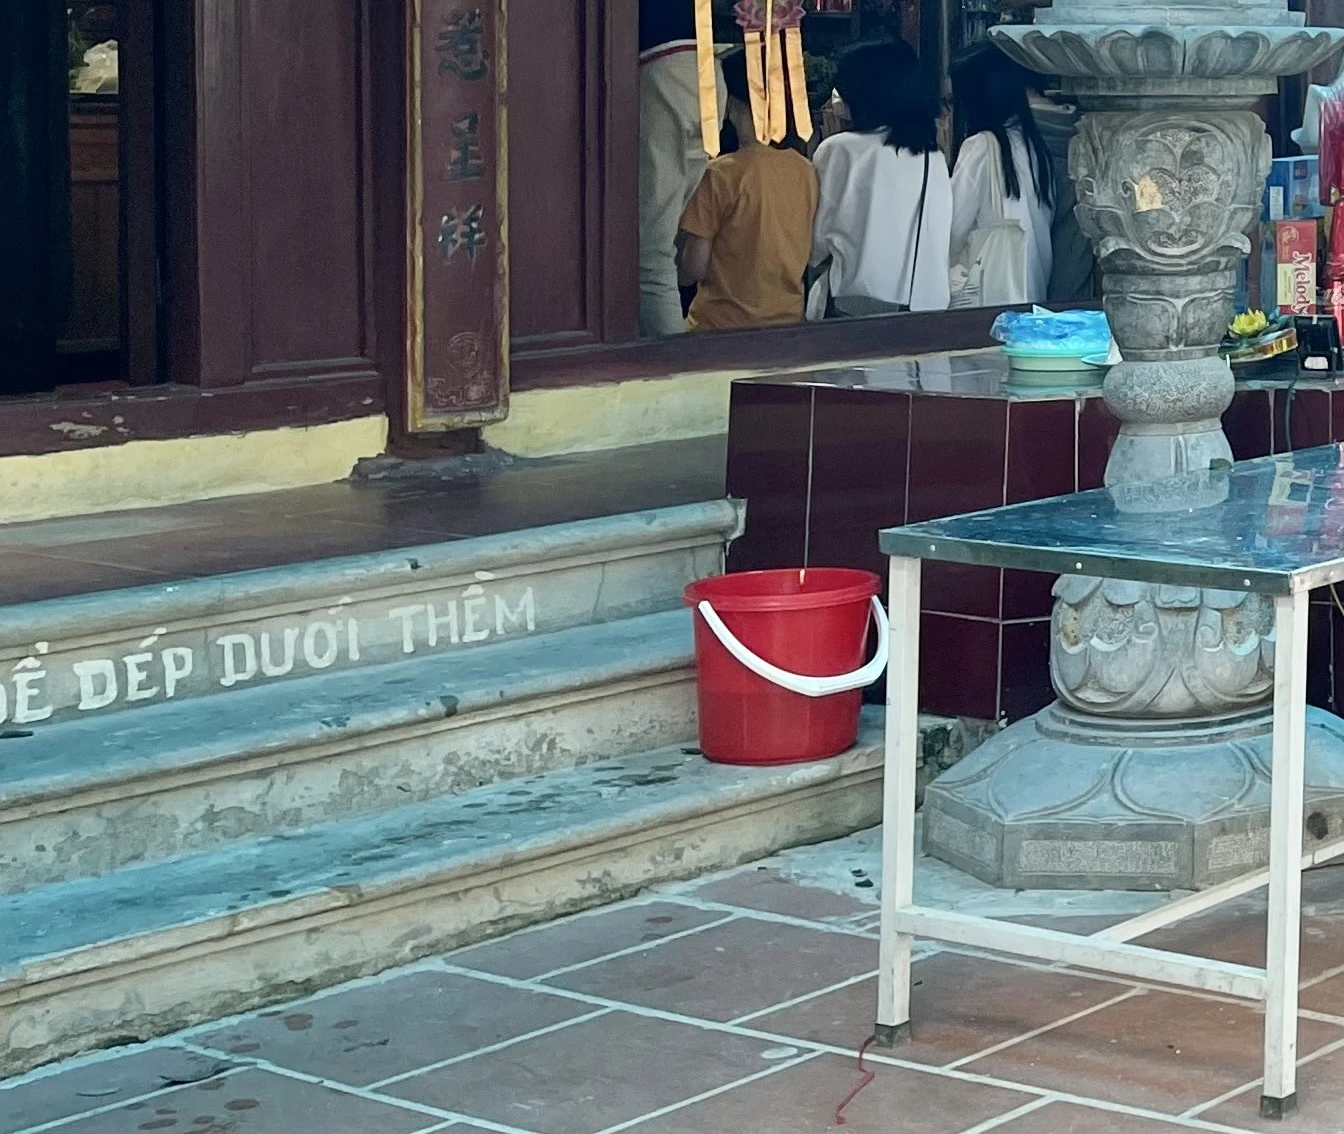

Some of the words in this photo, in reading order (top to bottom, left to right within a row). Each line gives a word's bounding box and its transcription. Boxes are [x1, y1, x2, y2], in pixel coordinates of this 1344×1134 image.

[1291, 250, 1313, 316] Melody
[73, 627, 193, 711] DÉP
[216, 596, 360, 687] DƯỚI
